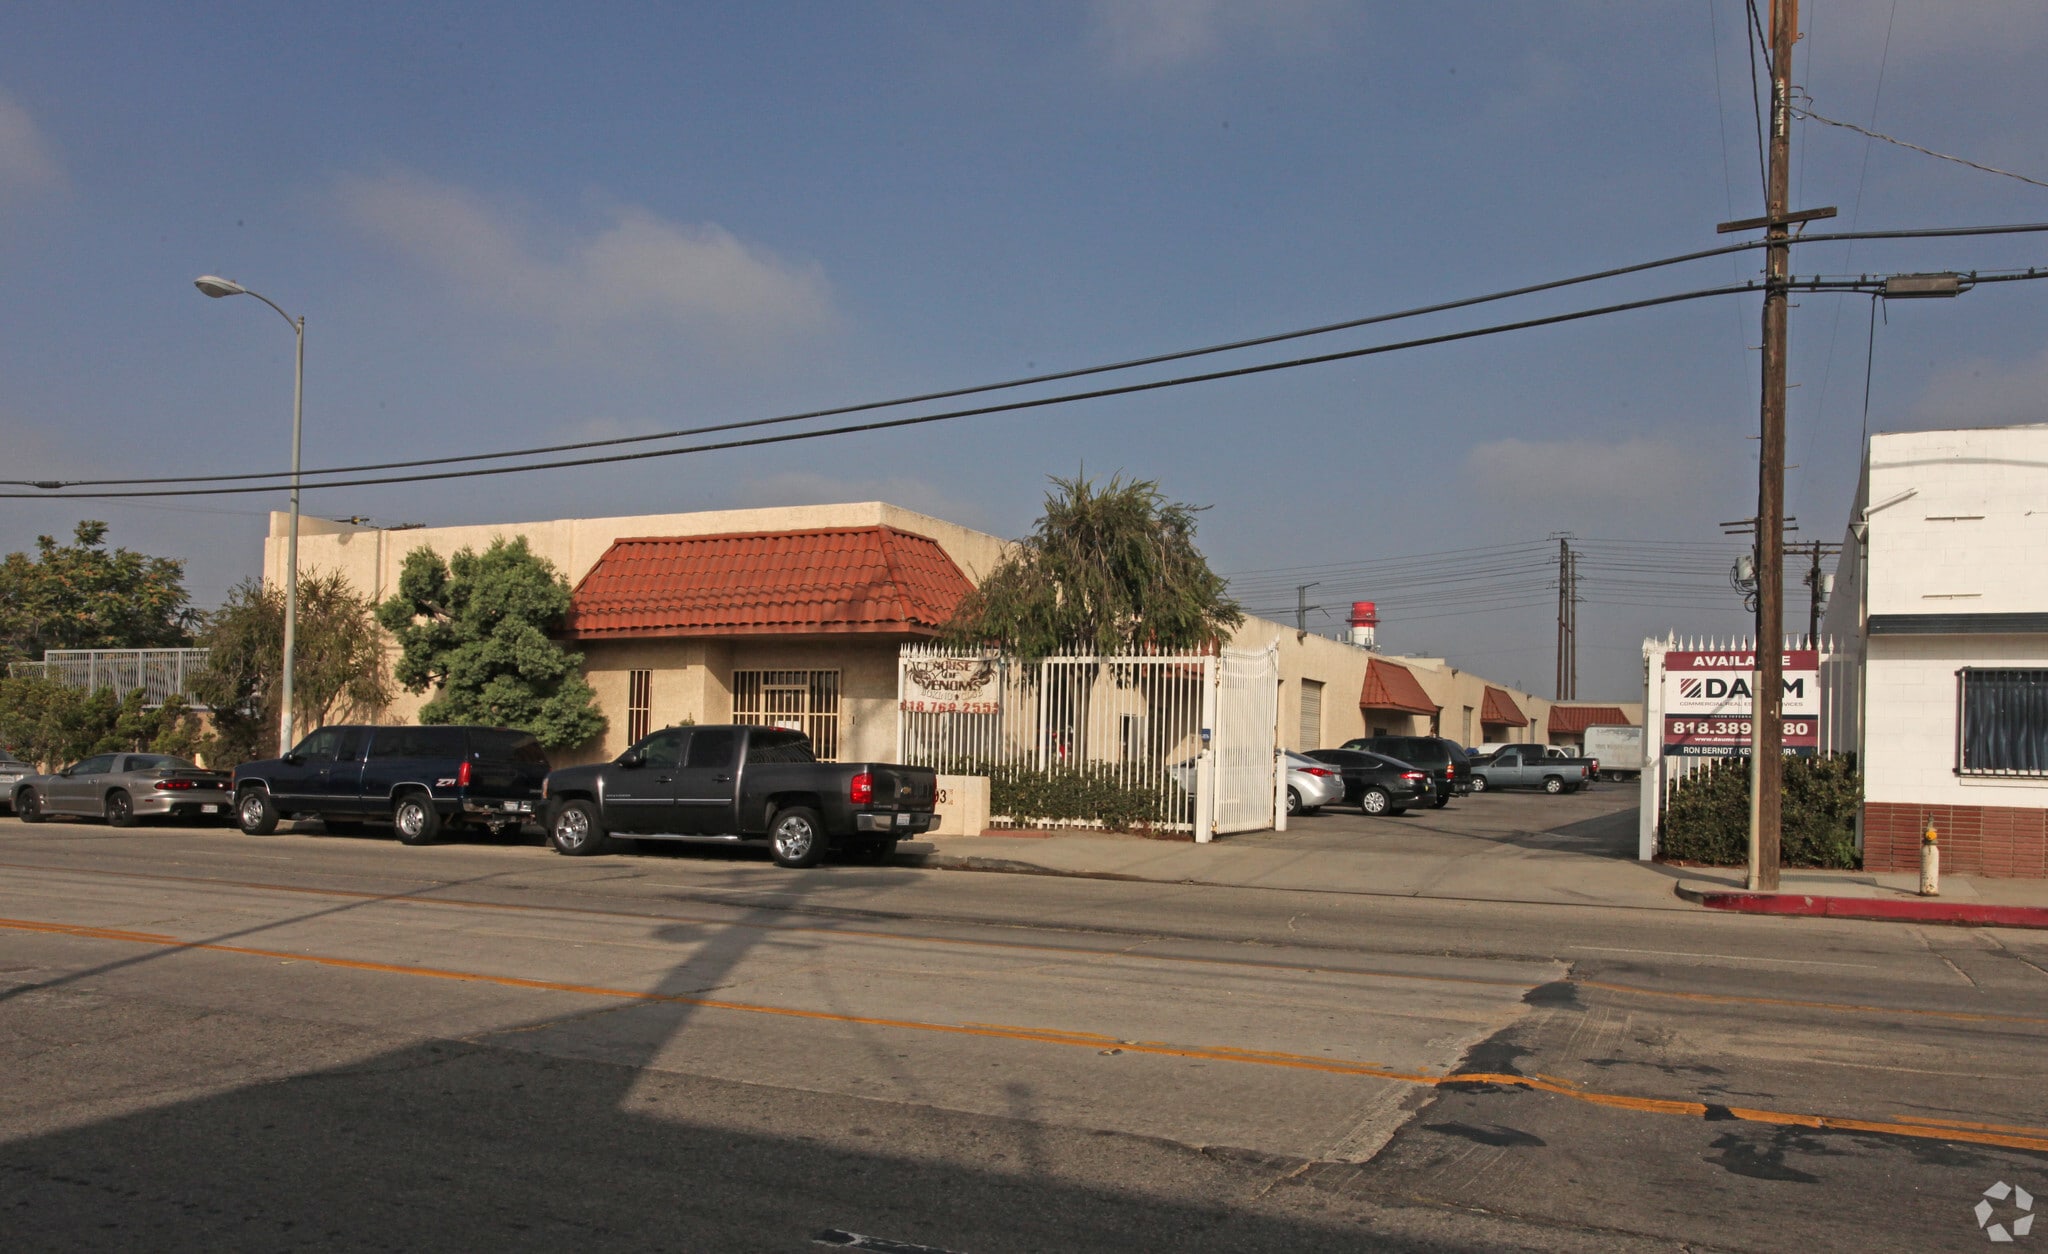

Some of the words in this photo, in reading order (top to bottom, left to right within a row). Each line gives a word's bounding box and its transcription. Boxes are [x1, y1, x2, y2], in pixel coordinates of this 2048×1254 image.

[933, 661, 971, 671] HOUSE
[1693, 655, 1791, 666] AVAILAE
[921, 680, 983, 691] VENOMS
[1706, 678, 1804, 698] DAM
[1673, 722, 1808, 735] 818.38980
[1702, 747, 1733, 755] BERNDT
